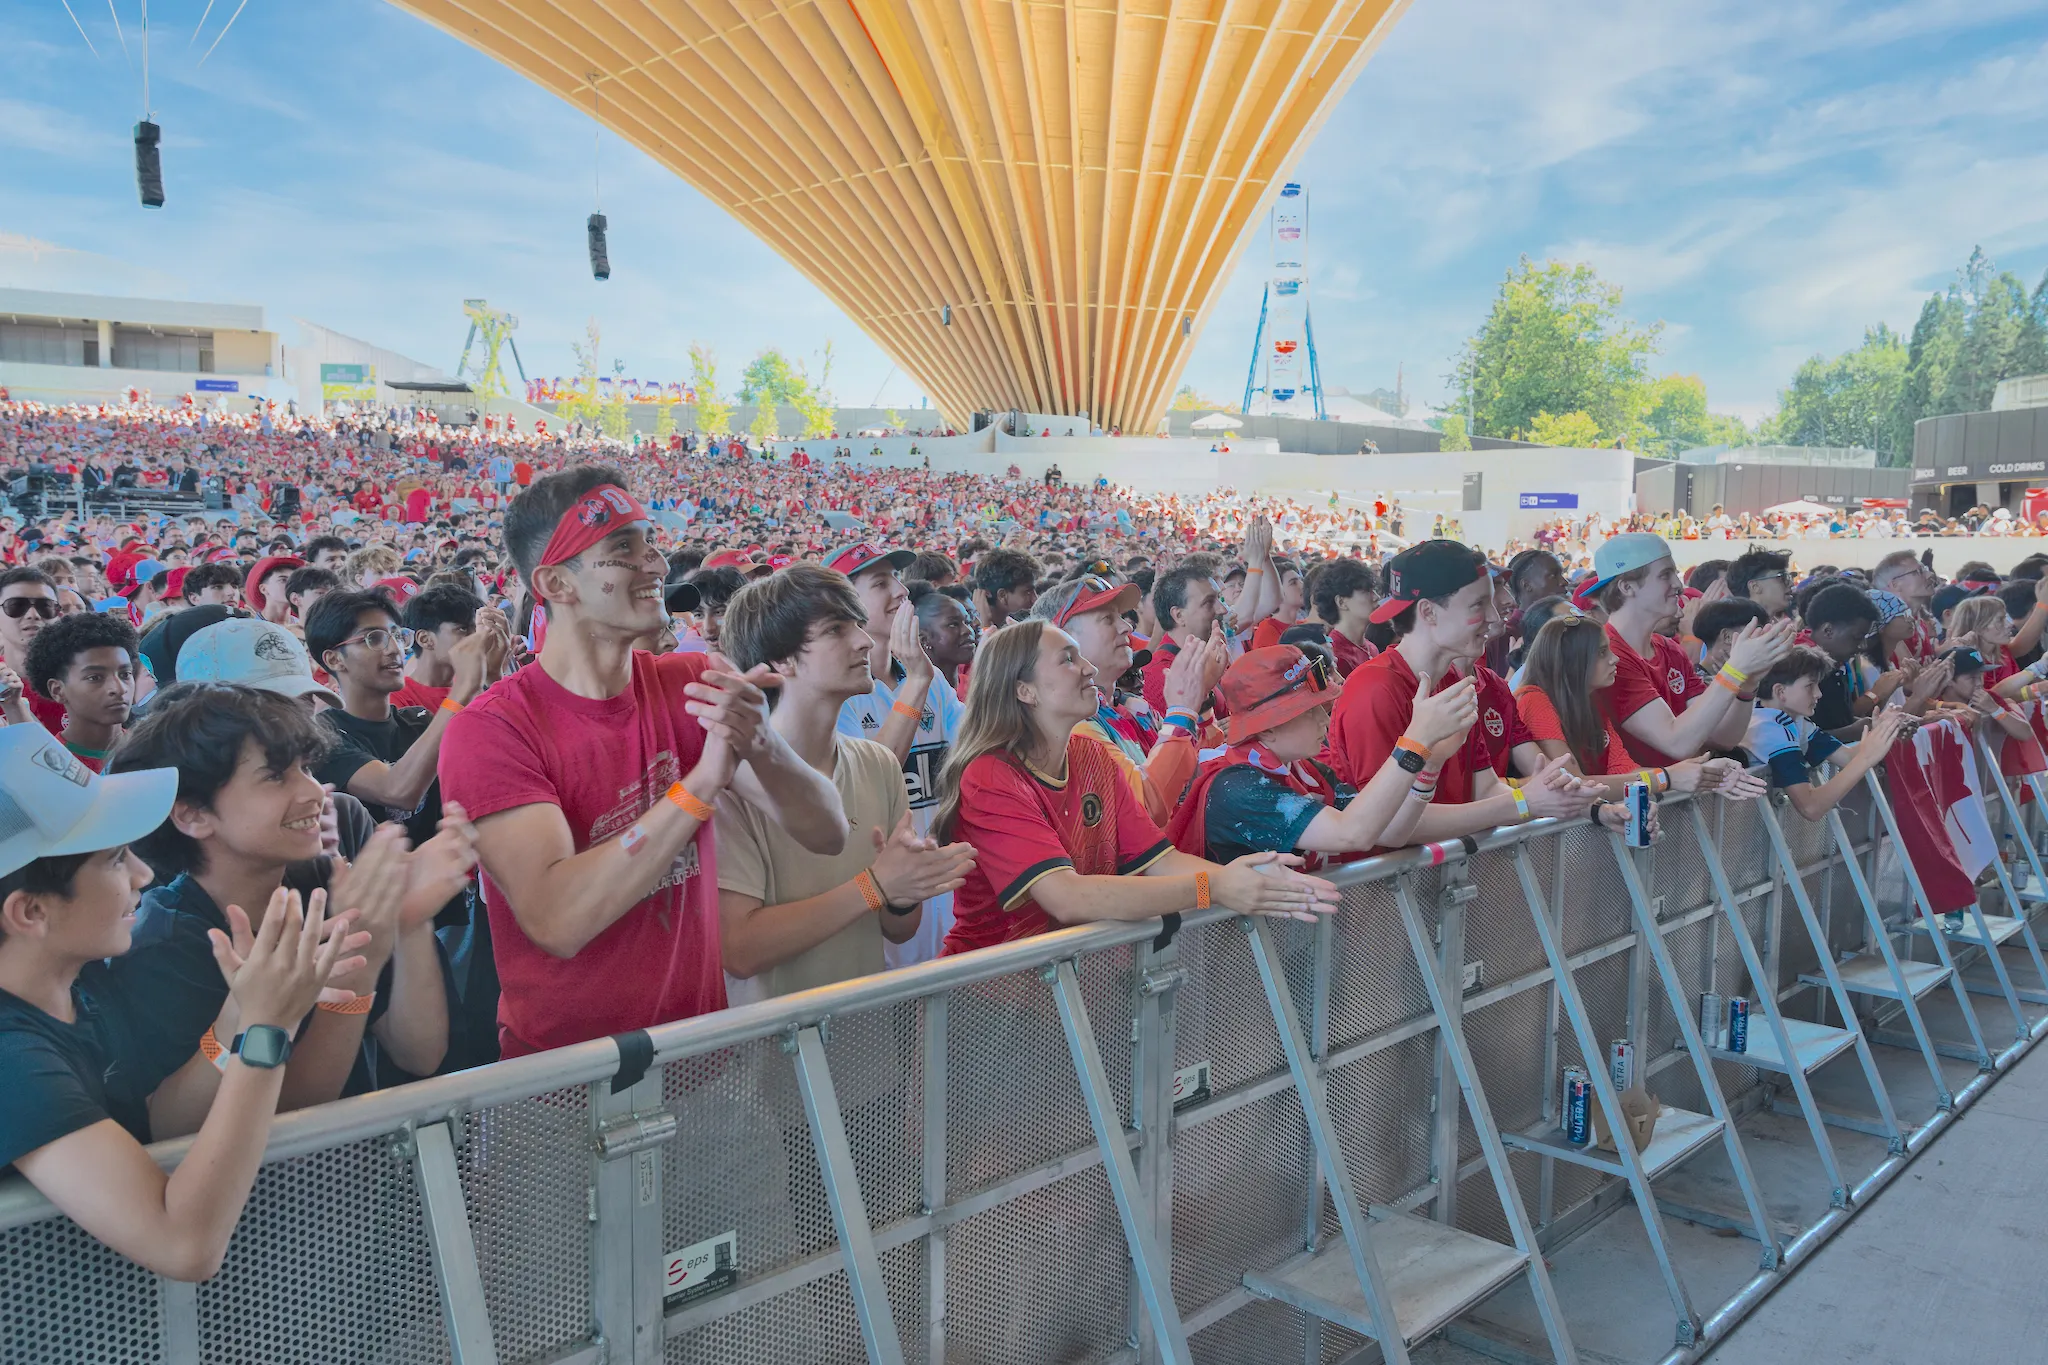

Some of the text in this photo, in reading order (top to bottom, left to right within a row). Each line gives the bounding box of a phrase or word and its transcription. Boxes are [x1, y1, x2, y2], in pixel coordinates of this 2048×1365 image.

[1948, 466, 1968, 476] BEER
[1989, 461, 2045, 473] COLD DRINKS
[606, 560, 638, 571] CANADA
[903, 753, 932, 801] ell
[1737, 1016, 1745, 1045] ULTRA
[1574, 1099, 1584, 1134] ULTRA
[687, 1253, 709, 1269] eps
[686, 1282, 710, 1296] Systems
